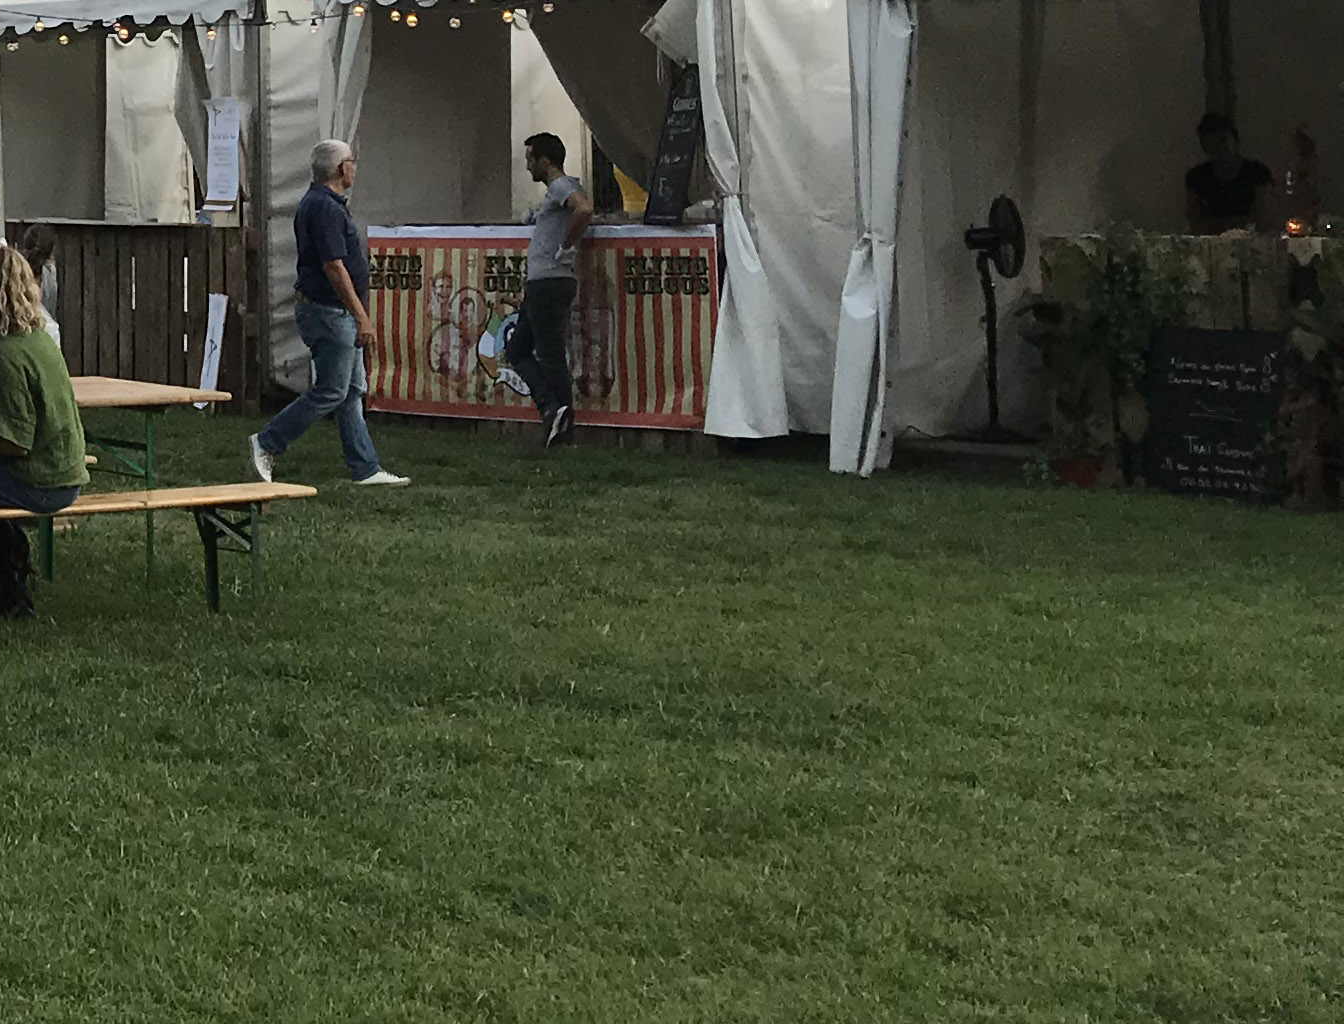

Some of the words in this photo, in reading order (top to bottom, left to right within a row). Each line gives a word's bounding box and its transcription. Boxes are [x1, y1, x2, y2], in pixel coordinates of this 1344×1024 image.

[368, 255, 422, 272] YING
[485, 256, 528, 274] FLY
[624, 256, 708, 275] FLYING
[368, 273, 422, 290] RCUS
[483, 275, 528, 292] CIR
[624, 276, 709, 295] CIRCUS
